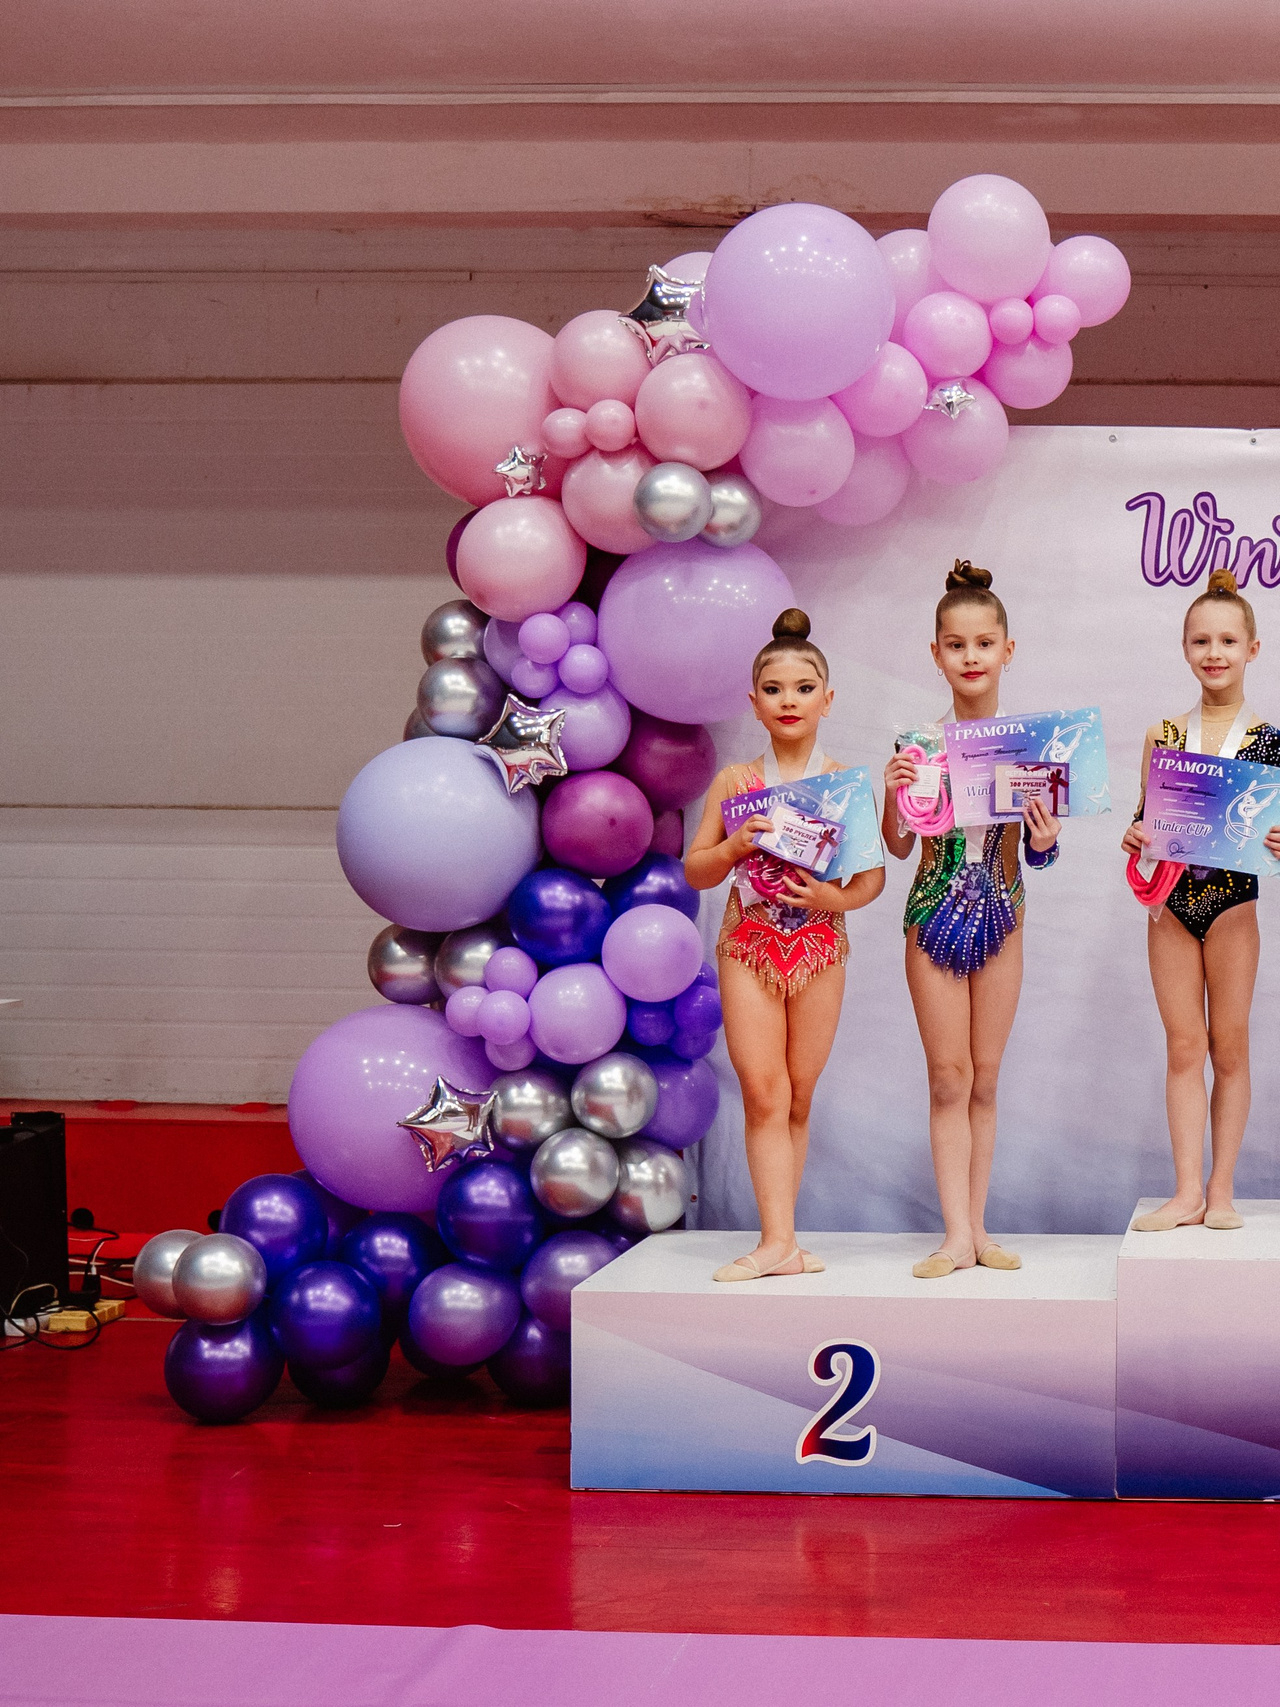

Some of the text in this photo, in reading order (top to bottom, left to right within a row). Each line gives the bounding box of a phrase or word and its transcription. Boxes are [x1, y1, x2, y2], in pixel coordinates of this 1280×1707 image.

[954, 723, 1026, 741] ГРАМОТА
[1157, 758, 1224, 778] ГРАМОТА
[730, 790, 796, 819] ГРАМОТА
[793, 830, 818, 841] РУБЛЕЙ
[1152, 818, 1213, 838] Winter CUP
[795, 1337, 881, 1468] 2
